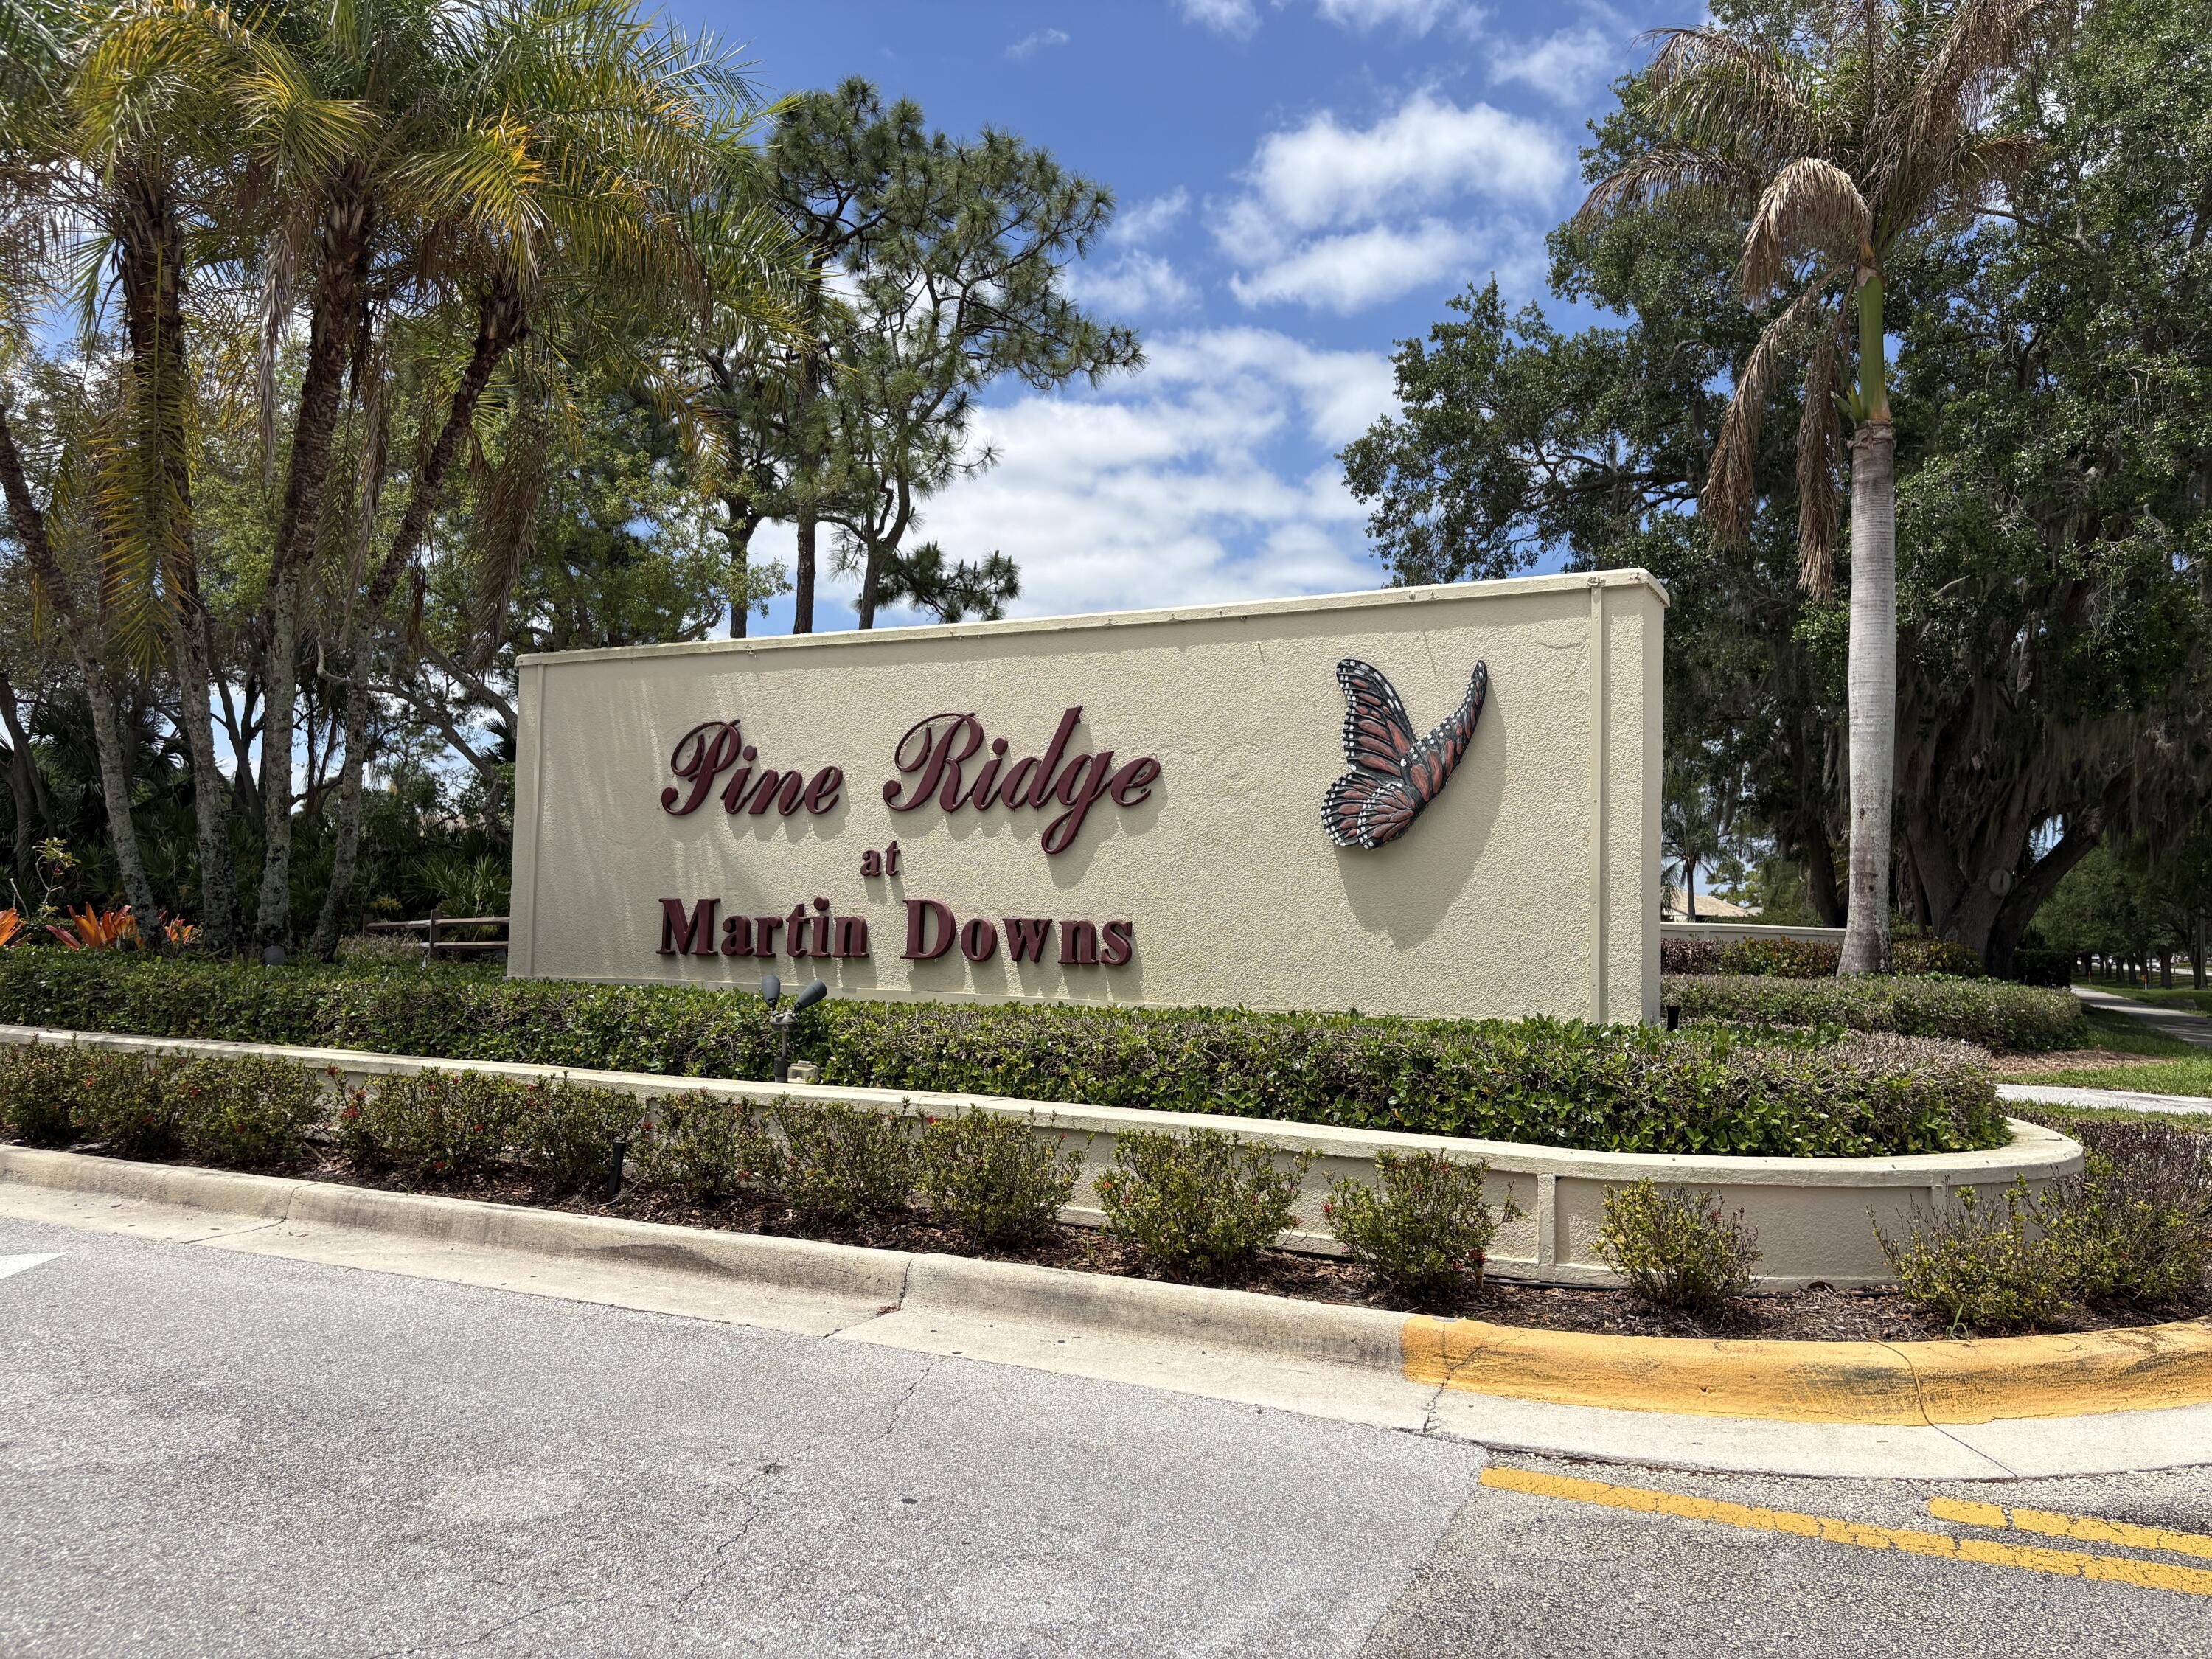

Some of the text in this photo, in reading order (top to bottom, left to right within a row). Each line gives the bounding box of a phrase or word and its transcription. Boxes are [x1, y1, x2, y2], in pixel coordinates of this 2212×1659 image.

[661, 706, 1161, 855] Pine Ridge
[860, 840, 900, 877] at
[656, 897, 1133, 966] Martin Downs
